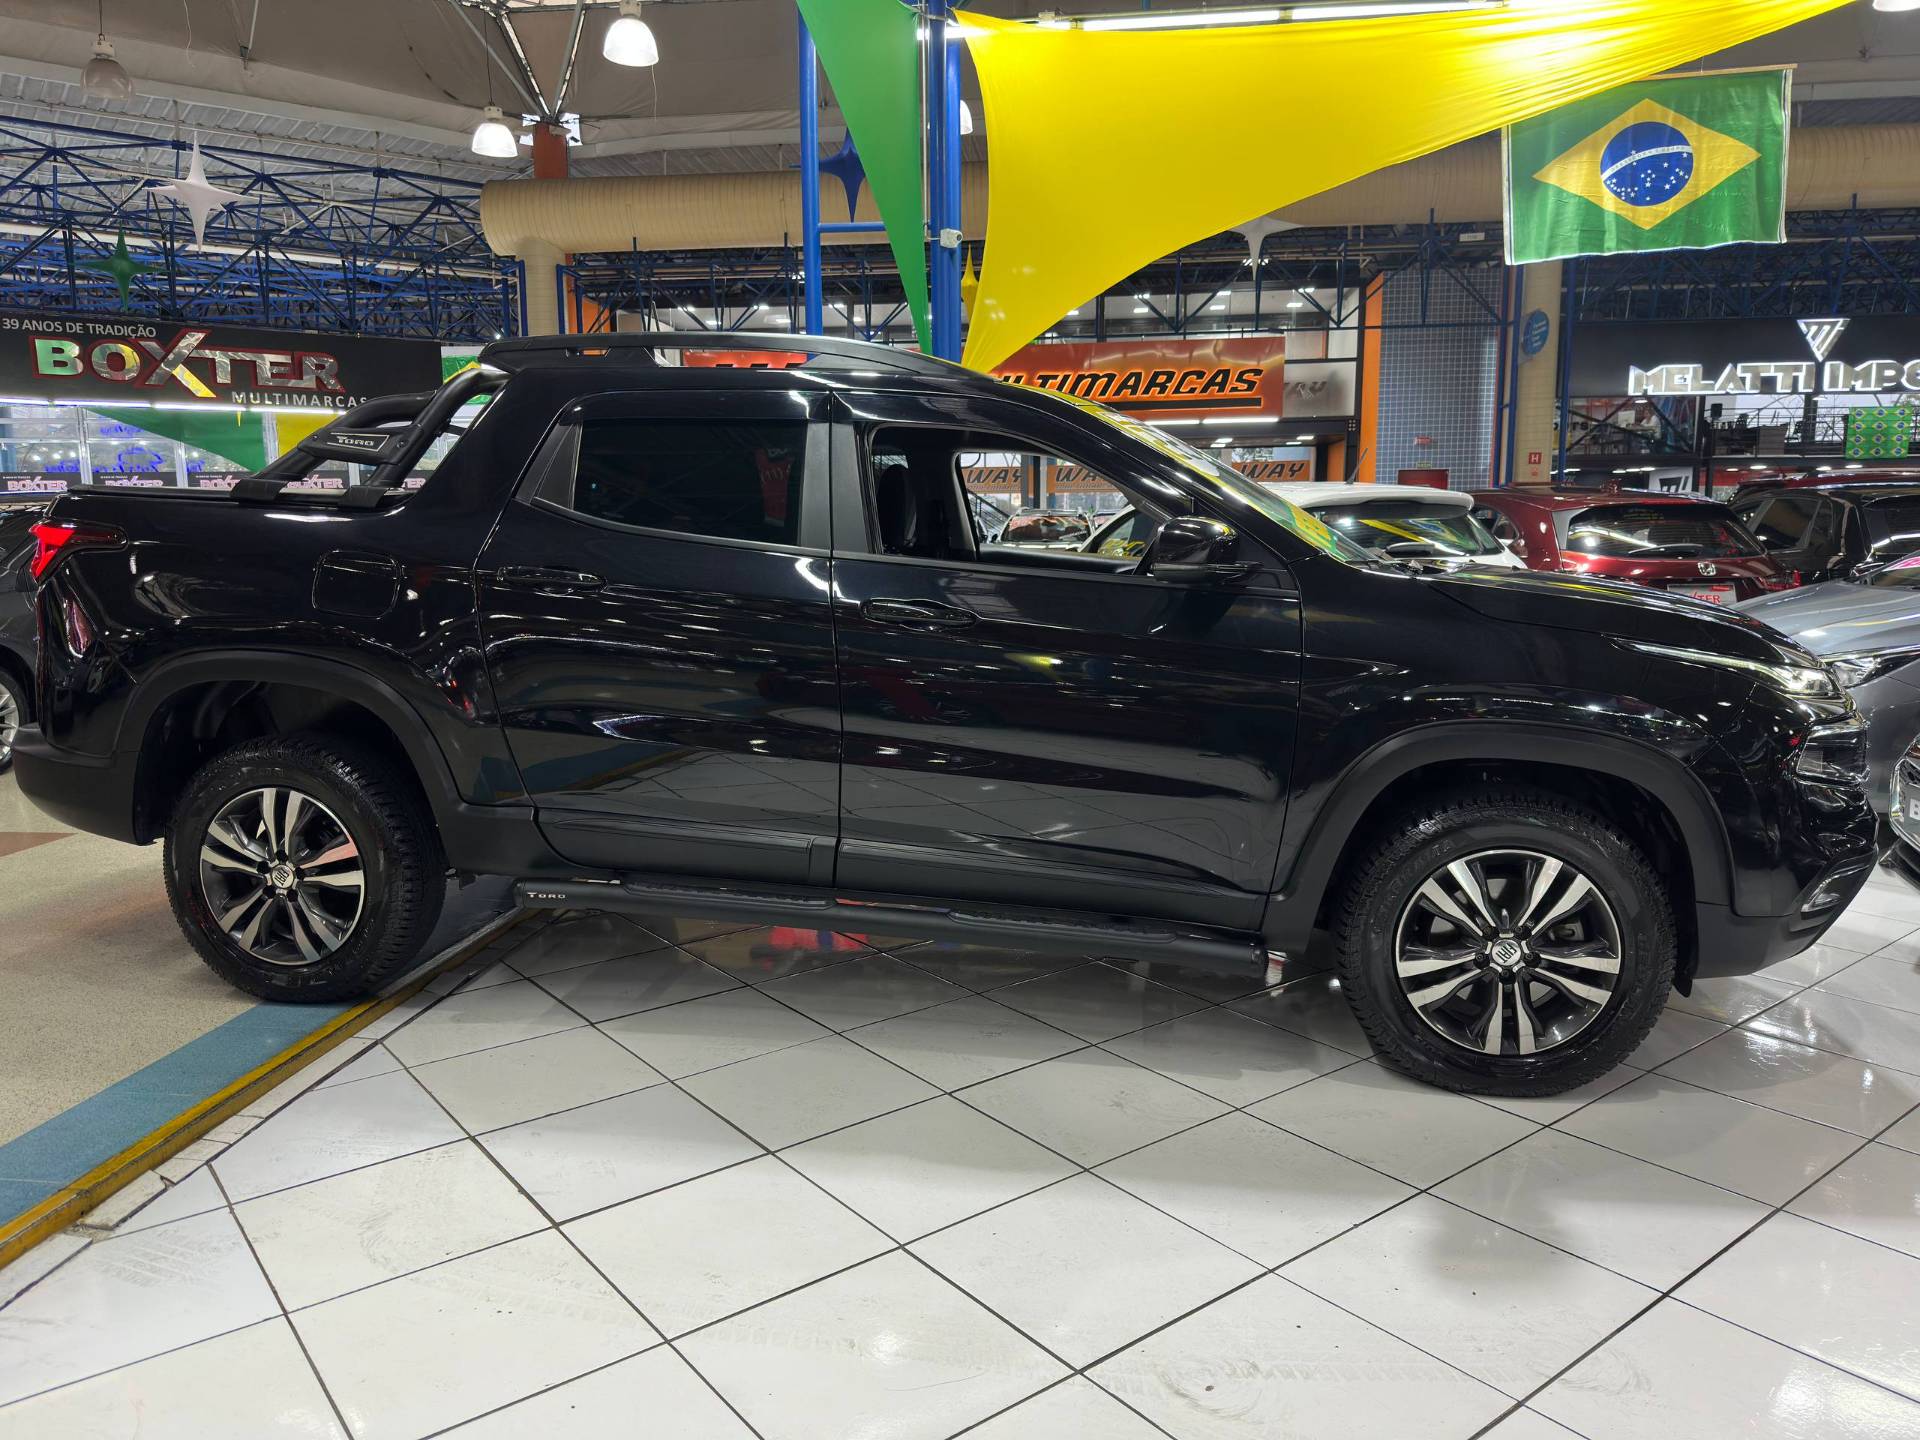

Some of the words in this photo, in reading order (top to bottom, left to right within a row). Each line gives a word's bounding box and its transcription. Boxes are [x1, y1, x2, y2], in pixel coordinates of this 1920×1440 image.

[2, 318, 19, 330] 39
[22, 319, 63, 333] ANOS
[66, 322, 85, 334] DE
[86, 323, 157, 339] TRADIÇÃO
[33, 330, 341, 398] BOXTER
[1628, 361, 1816, 396] MELATTI
[1240, 462, 1305, 479] WAY
[8, 476, 67, 491] BOXTER
[1495, 942, 1518, 964] FIAT
